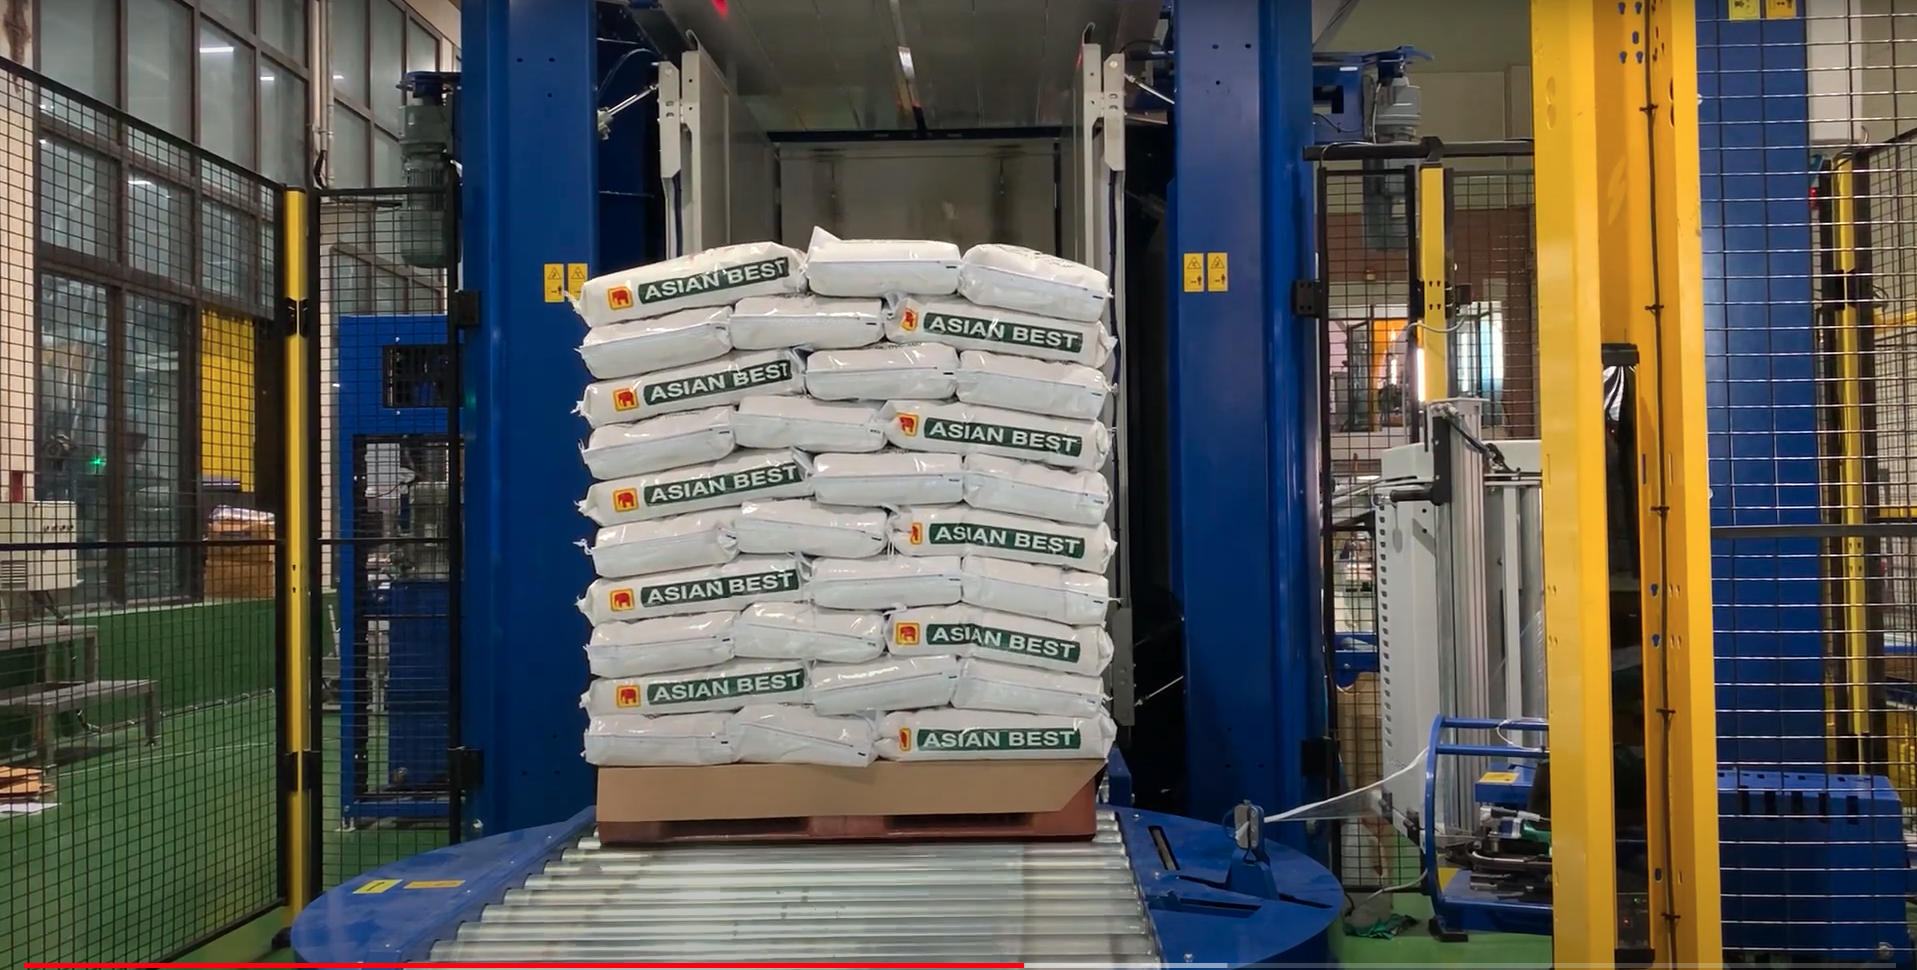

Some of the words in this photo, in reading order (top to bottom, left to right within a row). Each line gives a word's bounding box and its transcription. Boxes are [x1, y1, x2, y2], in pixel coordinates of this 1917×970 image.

[645, 273, 719, 300] ASIAN
[727, 260, 787, 283] BEST
[929, 316, 1004, 338] ASIAN
[1013, 327, 1078, 348] BEST
[651, 374, 724, 401] ASIAN
[733, 365, 789, 387] BEST
[929, 422, 1003, 443] ASIAN
[1012, 430, 1077, 454] BEST
[652, 478, 726, 502] ASIAN
[734, 465, 796, 490] BEST
[935, 525, 1006, 545] ASIAN
[1014, 534, 1080, 555] BEST
[648, 581, 723, 604] ASIAN
[729, 572, 793, 594] BEST
[931, 627, 1001, 647] ASIAN
[1009, 635, 1076, 658] BEST
[654, 680, 729, 701] ASIAN
[737, 672, 801, 691] BEST
[923, 732, 1000, 747] ASIAN
[1008, 730, 1075, 747] BEST
